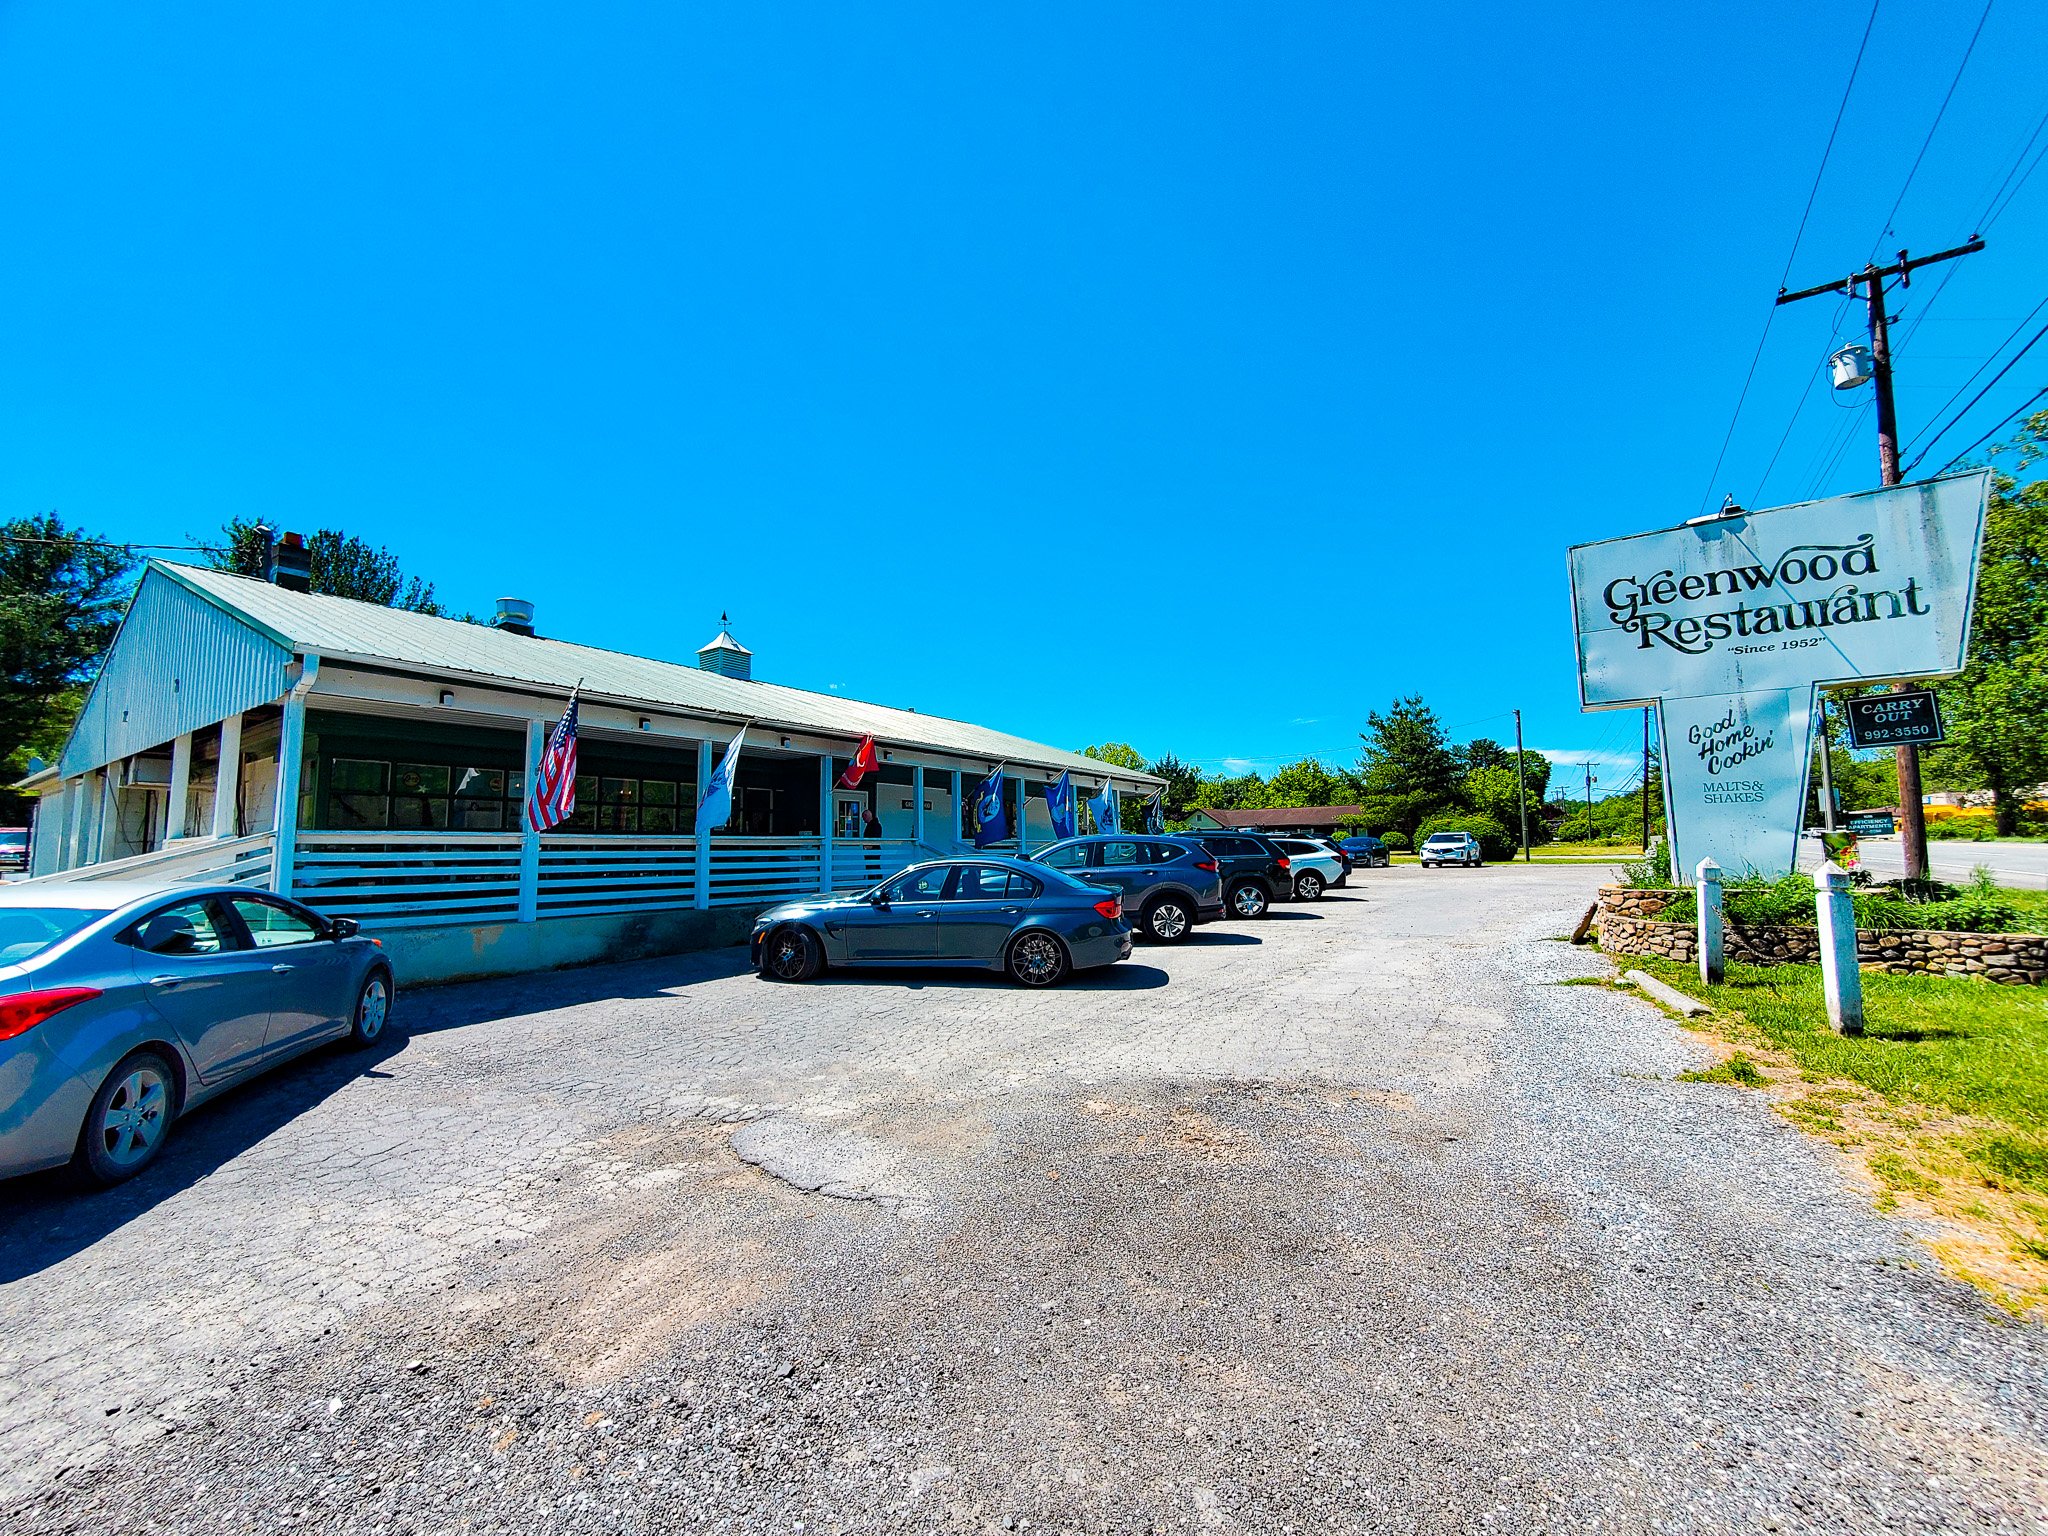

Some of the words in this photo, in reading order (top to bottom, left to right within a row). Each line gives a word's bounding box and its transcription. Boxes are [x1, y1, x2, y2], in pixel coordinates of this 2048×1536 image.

[1603, 533, 1880, 624] Greenwood
[1621, 576, 1931, 655] Restaurant
[1861, 698, 1924, 714] CARRY
[1874, 710, 1913, 723] OUT
[1688, 708, 1736, 744] Good
[1864, 725, 1929, 740] 992-3550
[1698, 725, 1754, 760] Home
[1707, 729, 1774, 775] Cookin'
[1702, 780, 1765, 792] MALTS&
[1703, 792, 1765, 804] SHAKES
